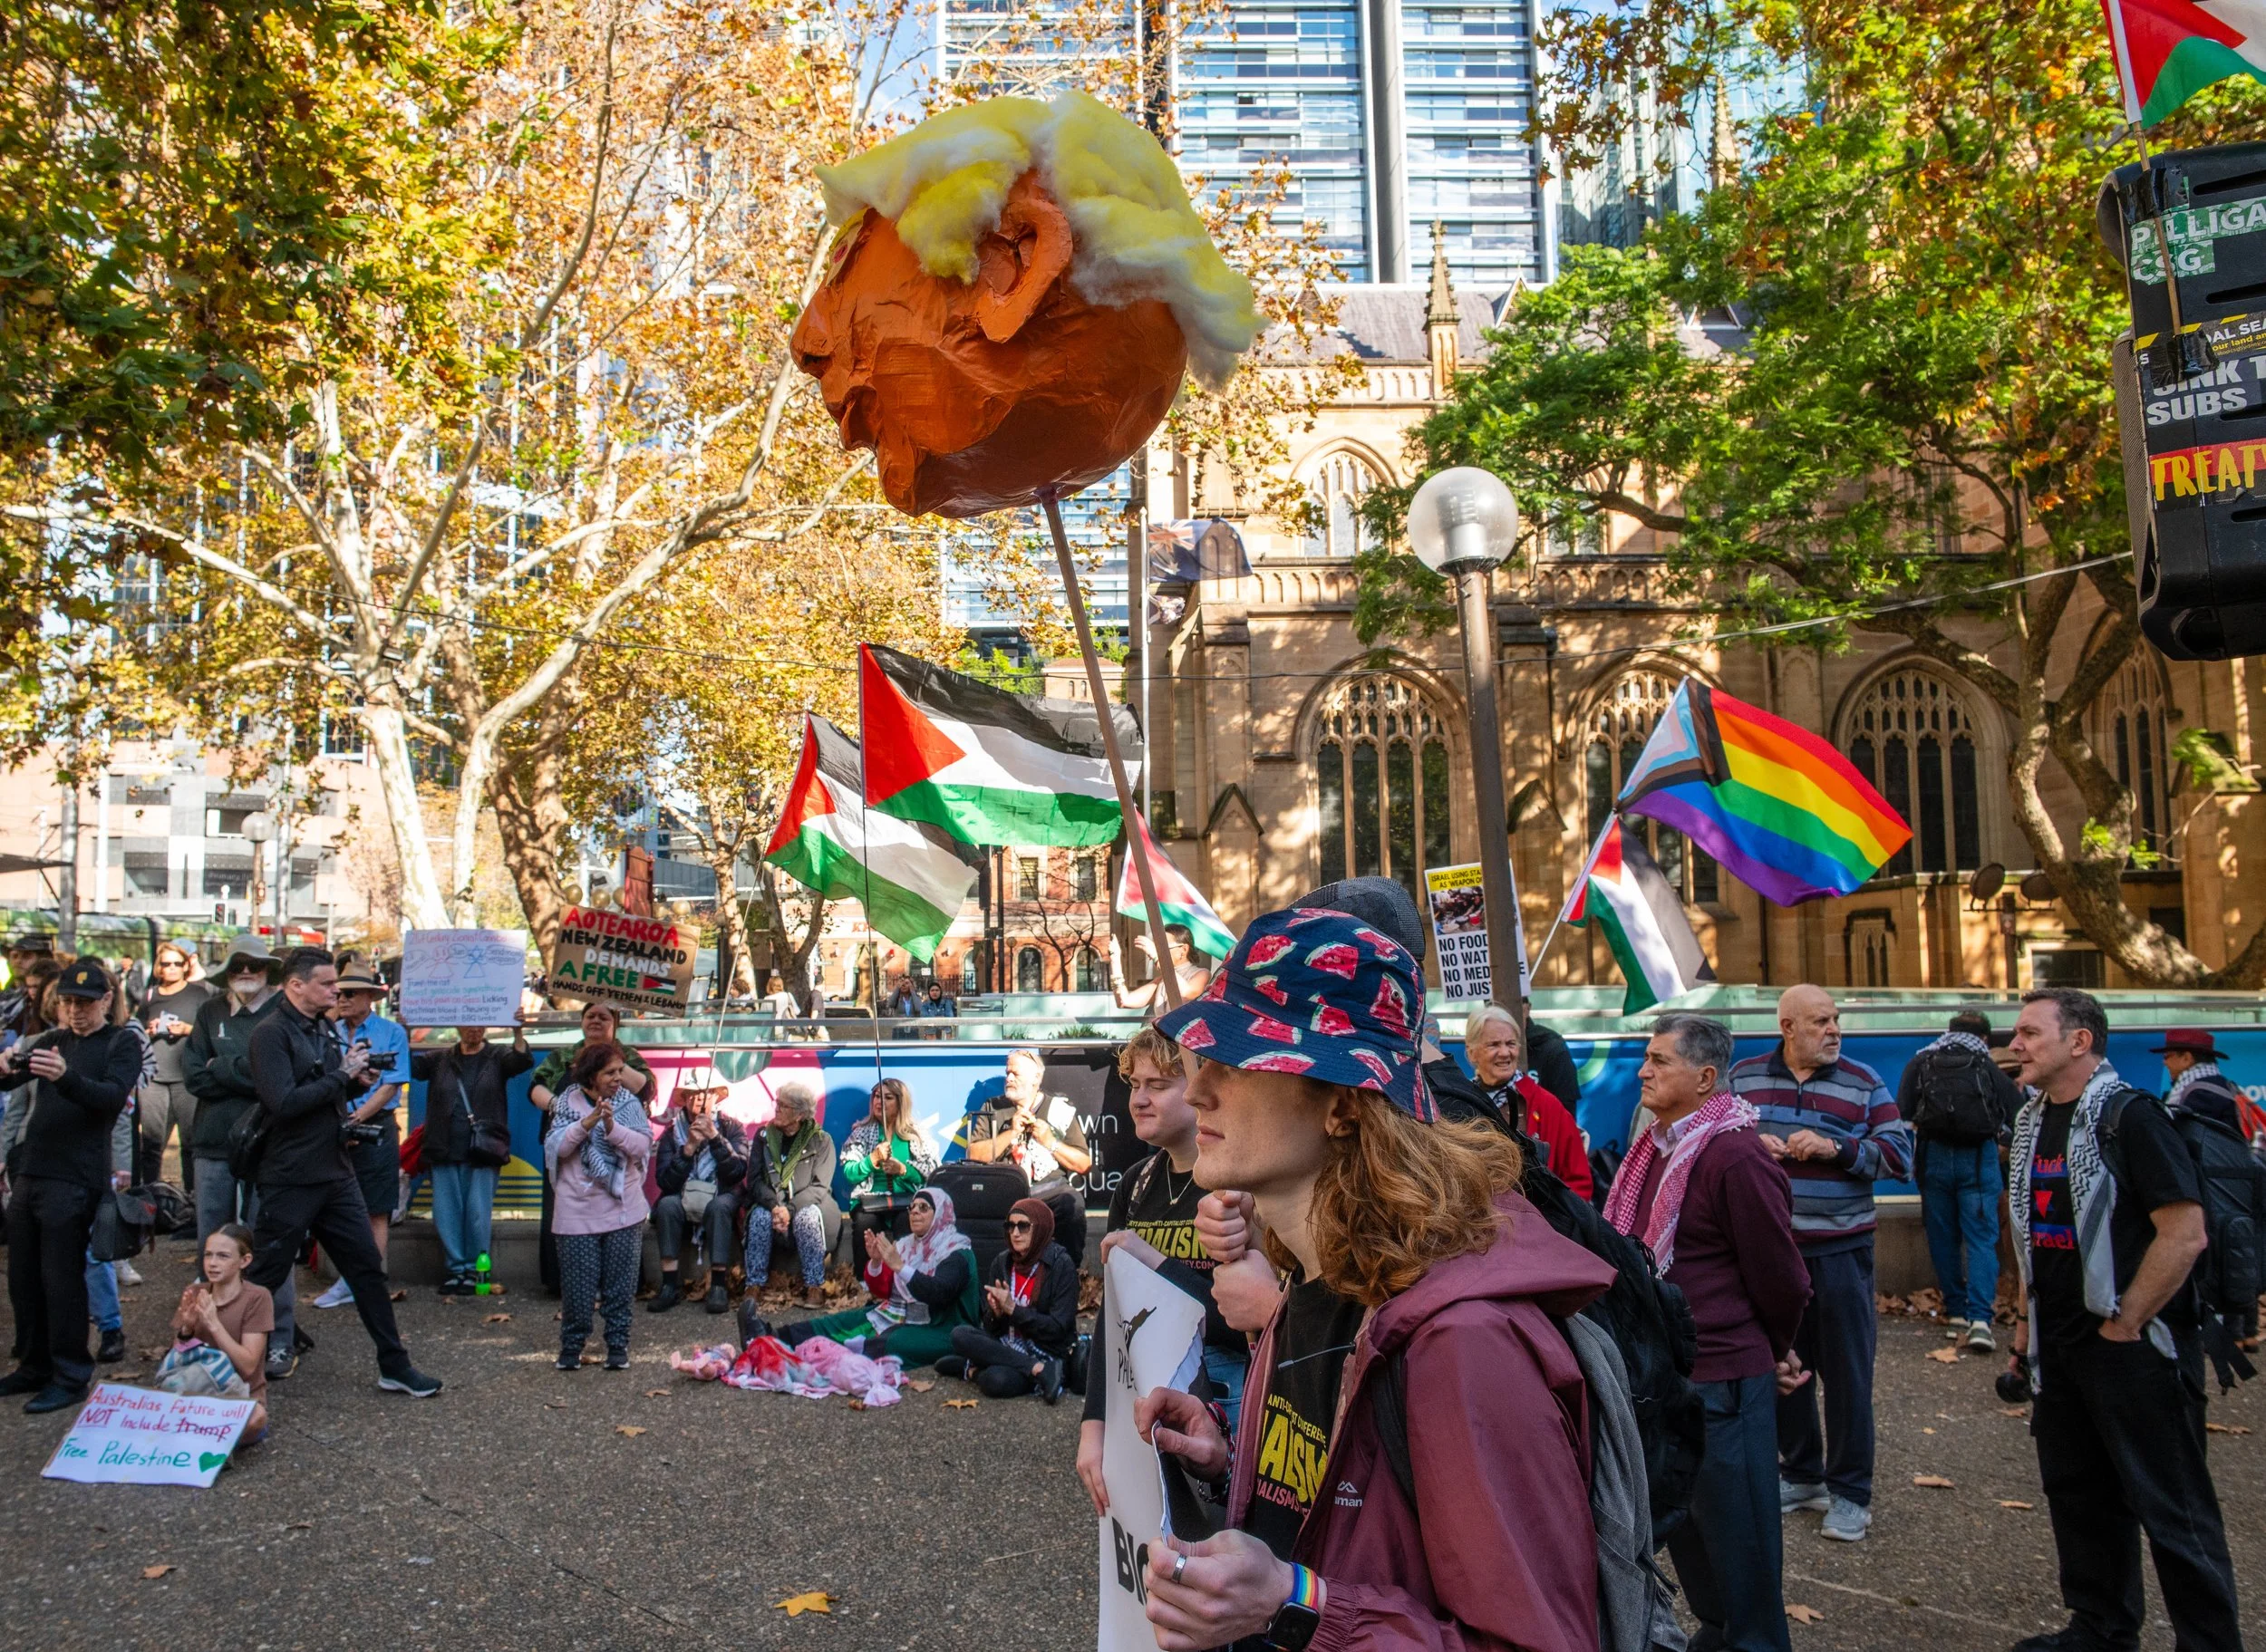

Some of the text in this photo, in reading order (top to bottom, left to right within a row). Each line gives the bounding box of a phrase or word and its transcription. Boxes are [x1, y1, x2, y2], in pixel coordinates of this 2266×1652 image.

[2212, 341, 2229, 352] our
[2232, 334, 2253, 346] land
[2146, 387, 2248, 426] SUBS
[2150, 444, 2266, 501] TREAT
[1431, 868, 1482, 881] ISRAEL USING STA
[564, 906, 679, 948] AOTEAROA
[560, 929, 687, 965] NEW ZEALAND
[1438, 938, 1455, 952] NO
[584, 949, 672, 977] DEMANDS
[1441, 953, 1457, 967] NO
[557, 960, 639, 989] A FREE
[1443, 968, 1460, 982] NO
[482, 995, 508, 1006] Licking
[553, 980, 583, 993] HANDS
[586, 985, 605, 997] OFF
[607, 988, 643, 1004] YEMEN
[651, 996, 686, 1010] LEBANON
[1446, 981, 1492, 999] NO JUS
[1180, 1260, 1215, 1270] EY.COM
[90, 1387, 161, 1412] Australias
[221, 1404, 247, 1419] will
[79, 1408, 120, 1425] NOT
[57, 1437, 192, 1467] Free Palestine
